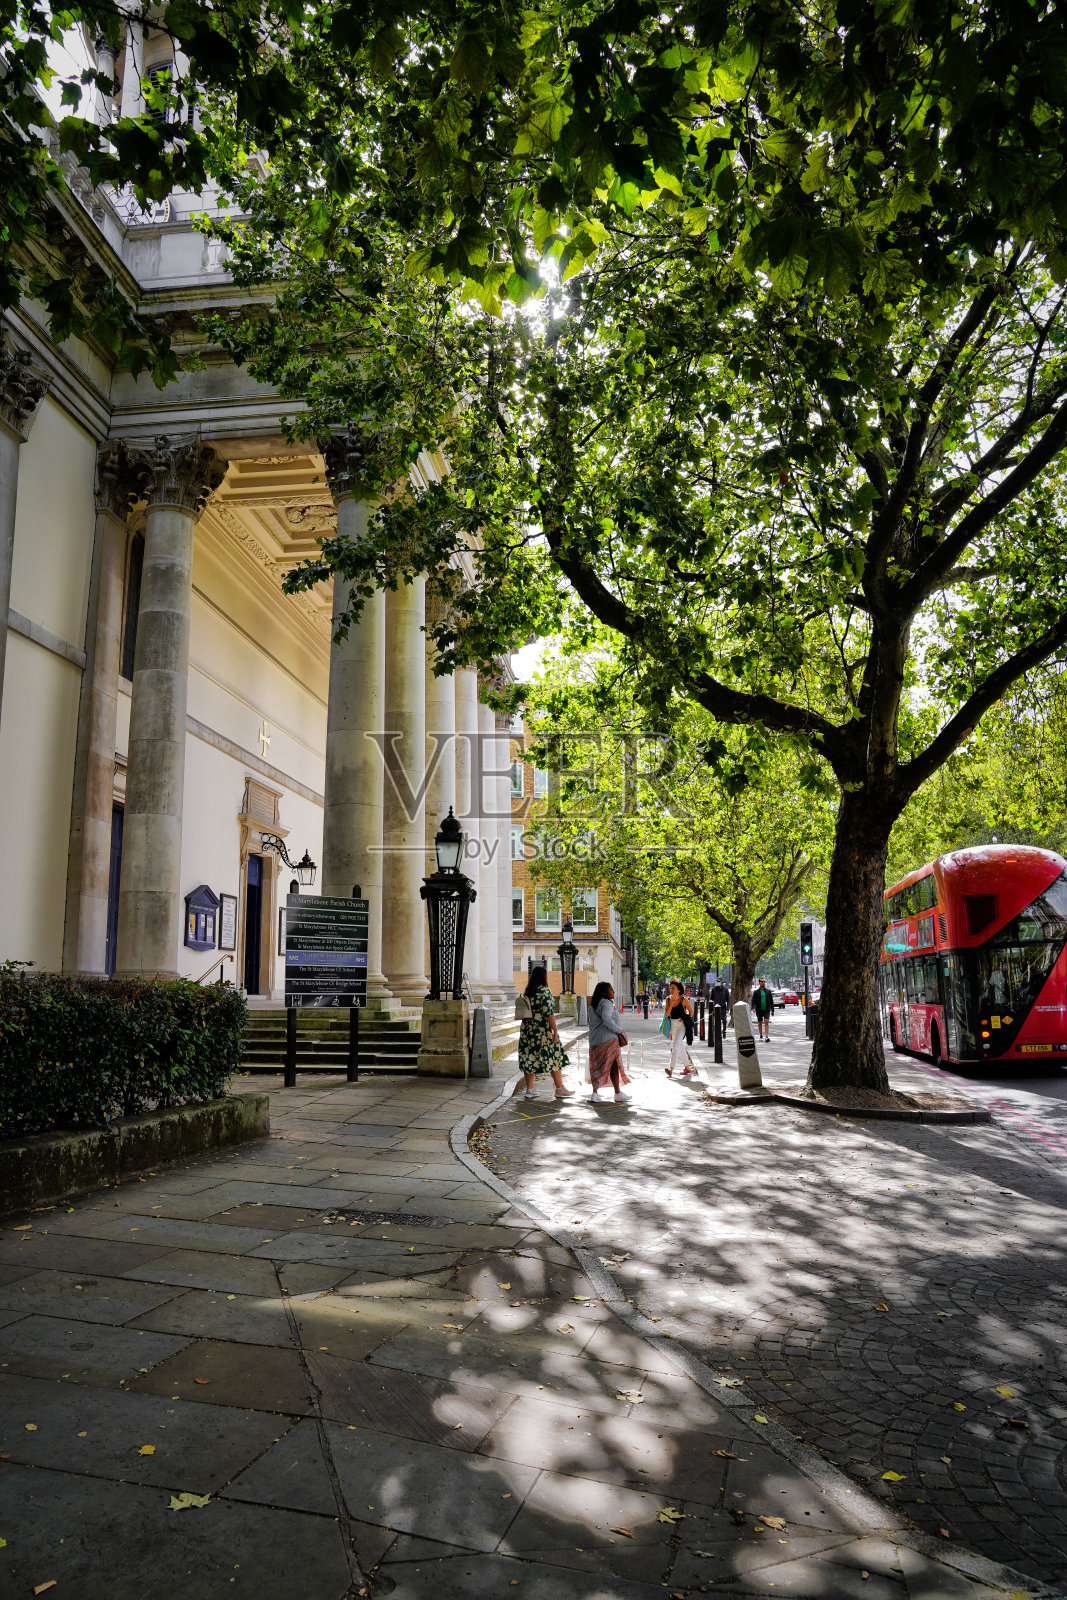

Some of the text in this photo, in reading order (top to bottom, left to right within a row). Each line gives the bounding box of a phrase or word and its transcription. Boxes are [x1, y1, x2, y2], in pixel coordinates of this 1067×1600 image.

[298, 898, 329, 906] Marylebone
[330, 899, 346, 907] Parish
[1020, 925, 1037, 940] 27
